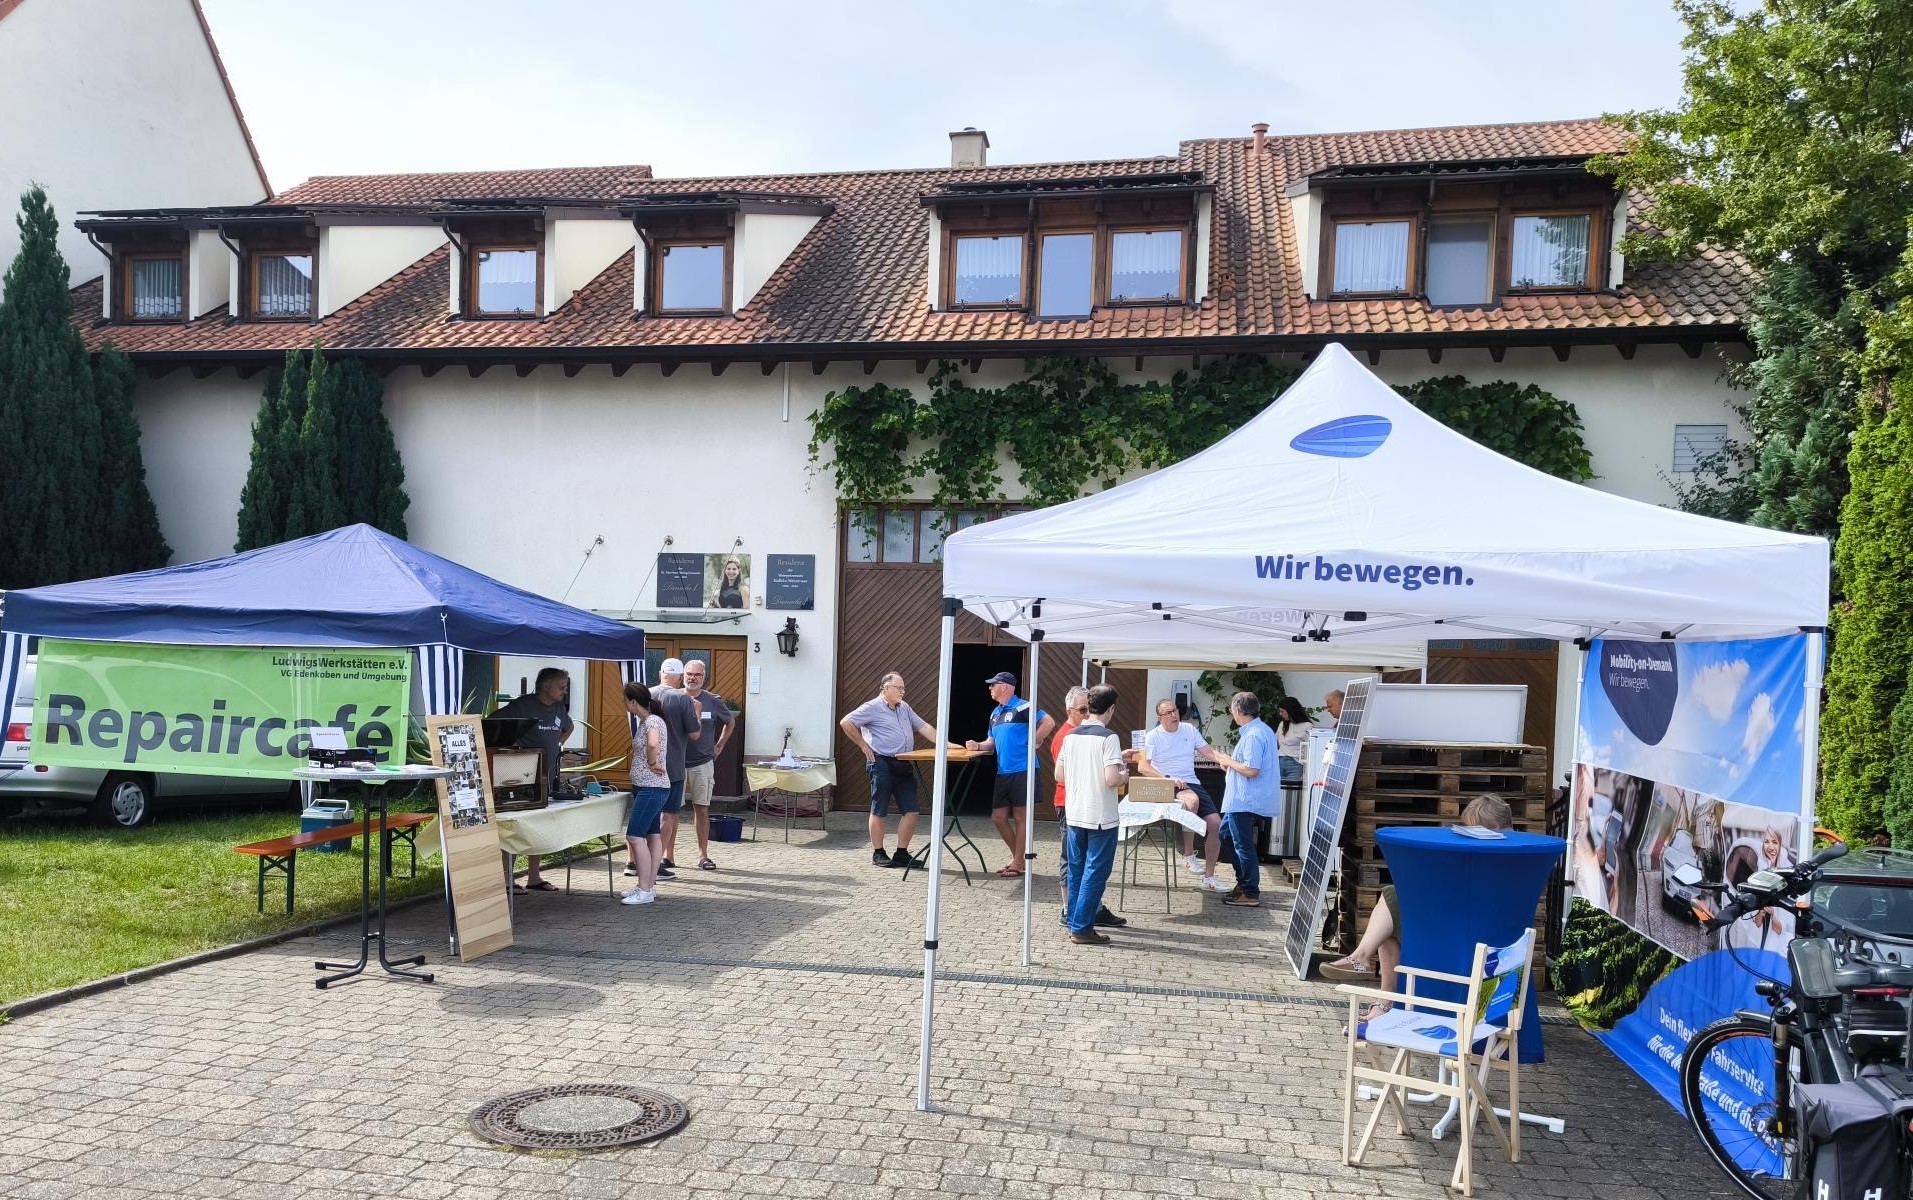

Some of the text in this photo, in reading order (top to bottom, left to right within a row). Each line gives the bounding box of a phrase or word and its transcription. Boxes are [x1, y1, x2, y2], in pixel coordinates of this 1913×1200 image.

[1255, 554, 1474, 591] Wir bewegen.
[754, 642, 760, 653] 3
[272, 656, 407, 669] LudwigsWerkstätten e.V.
[280, 669, 292, 677] VG
[294, 670, 341, 679] Edenkoben
[361, 672, 407, 682] Umgebung
[1609, 672, 1620, 687] Wir
[45, 693, 394, 763] Repaircafé
[451, 739, 467, 748] ALLES
[1660, 1007, 1677, 1034] Dein
[1711, 1045, 1764, 1097] Fahrservice
[1647, 1034, 1664, 1054] für
[1658, 1044, 1675, 1064] die
[1719, 1092, 1743, 1120] und
